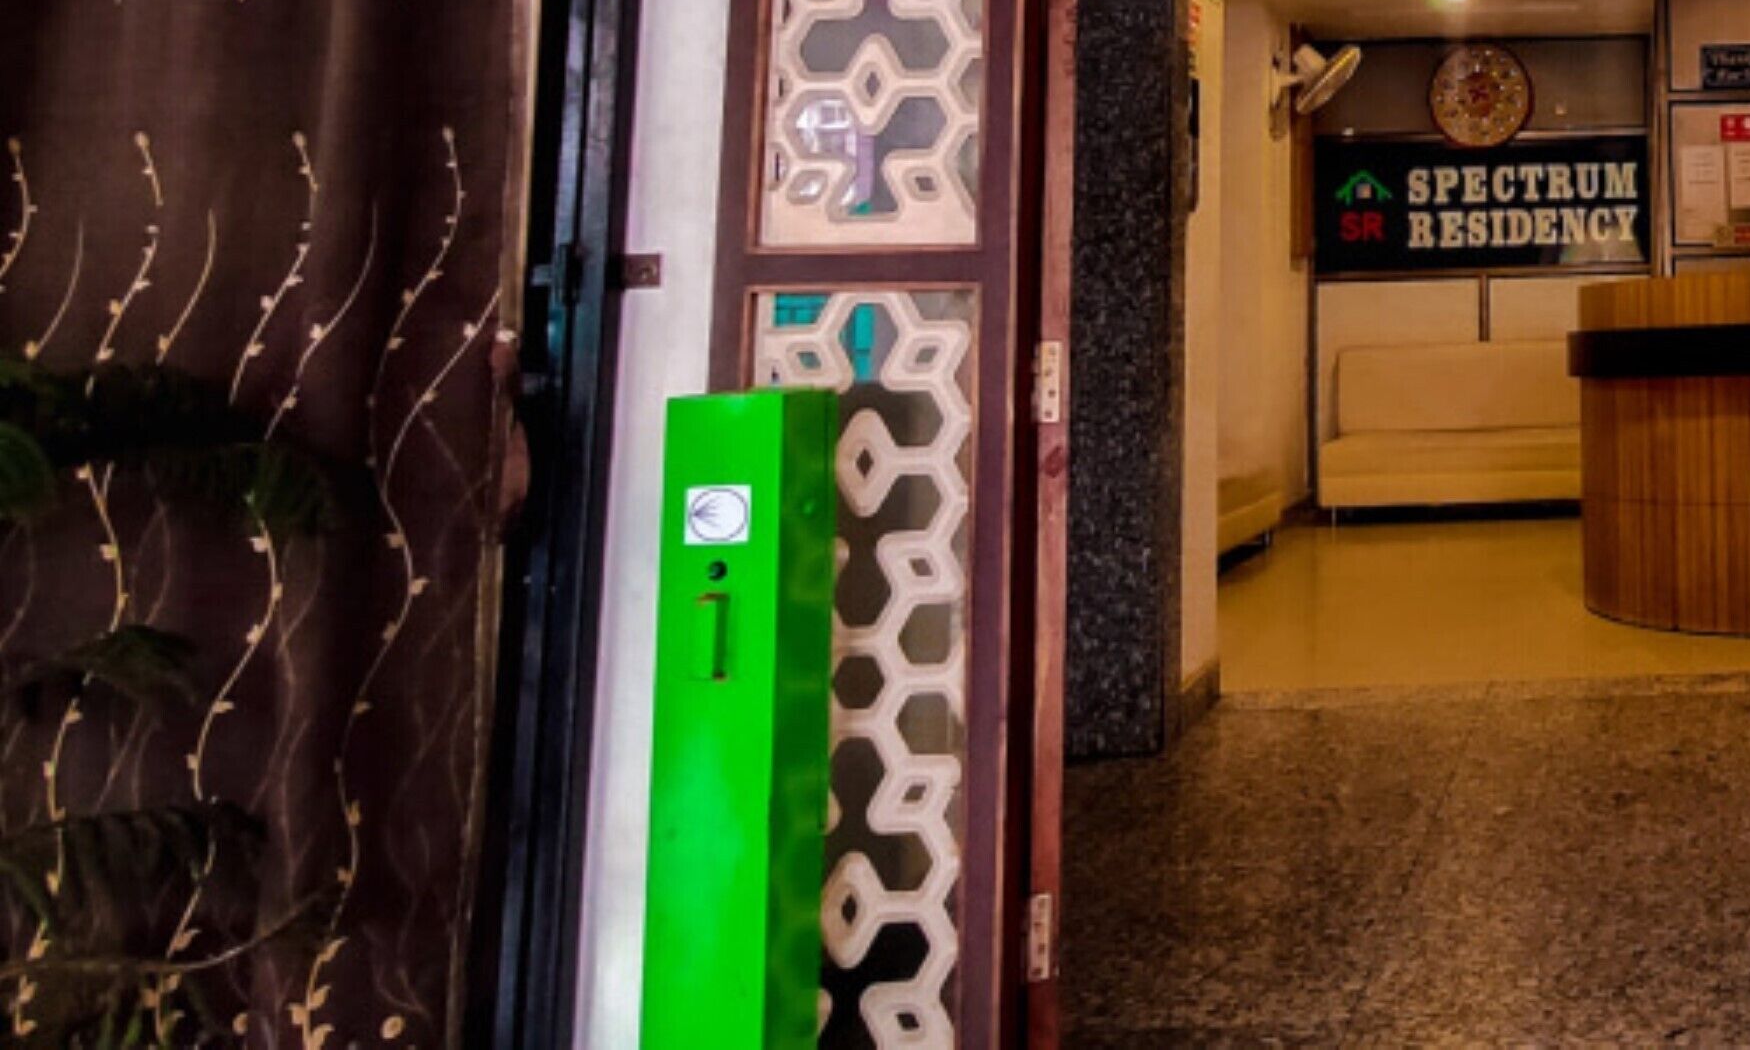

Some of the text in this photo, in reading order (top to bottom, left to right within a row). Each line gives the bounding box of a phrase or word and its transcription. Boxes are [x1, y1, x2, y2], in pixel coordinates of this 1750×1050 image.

[1407, 162, 1638, 204] SPECTRUM
[1339, 210, 1385, 242] SR
[1407, 205, 1638, 248] RESIDENCY
